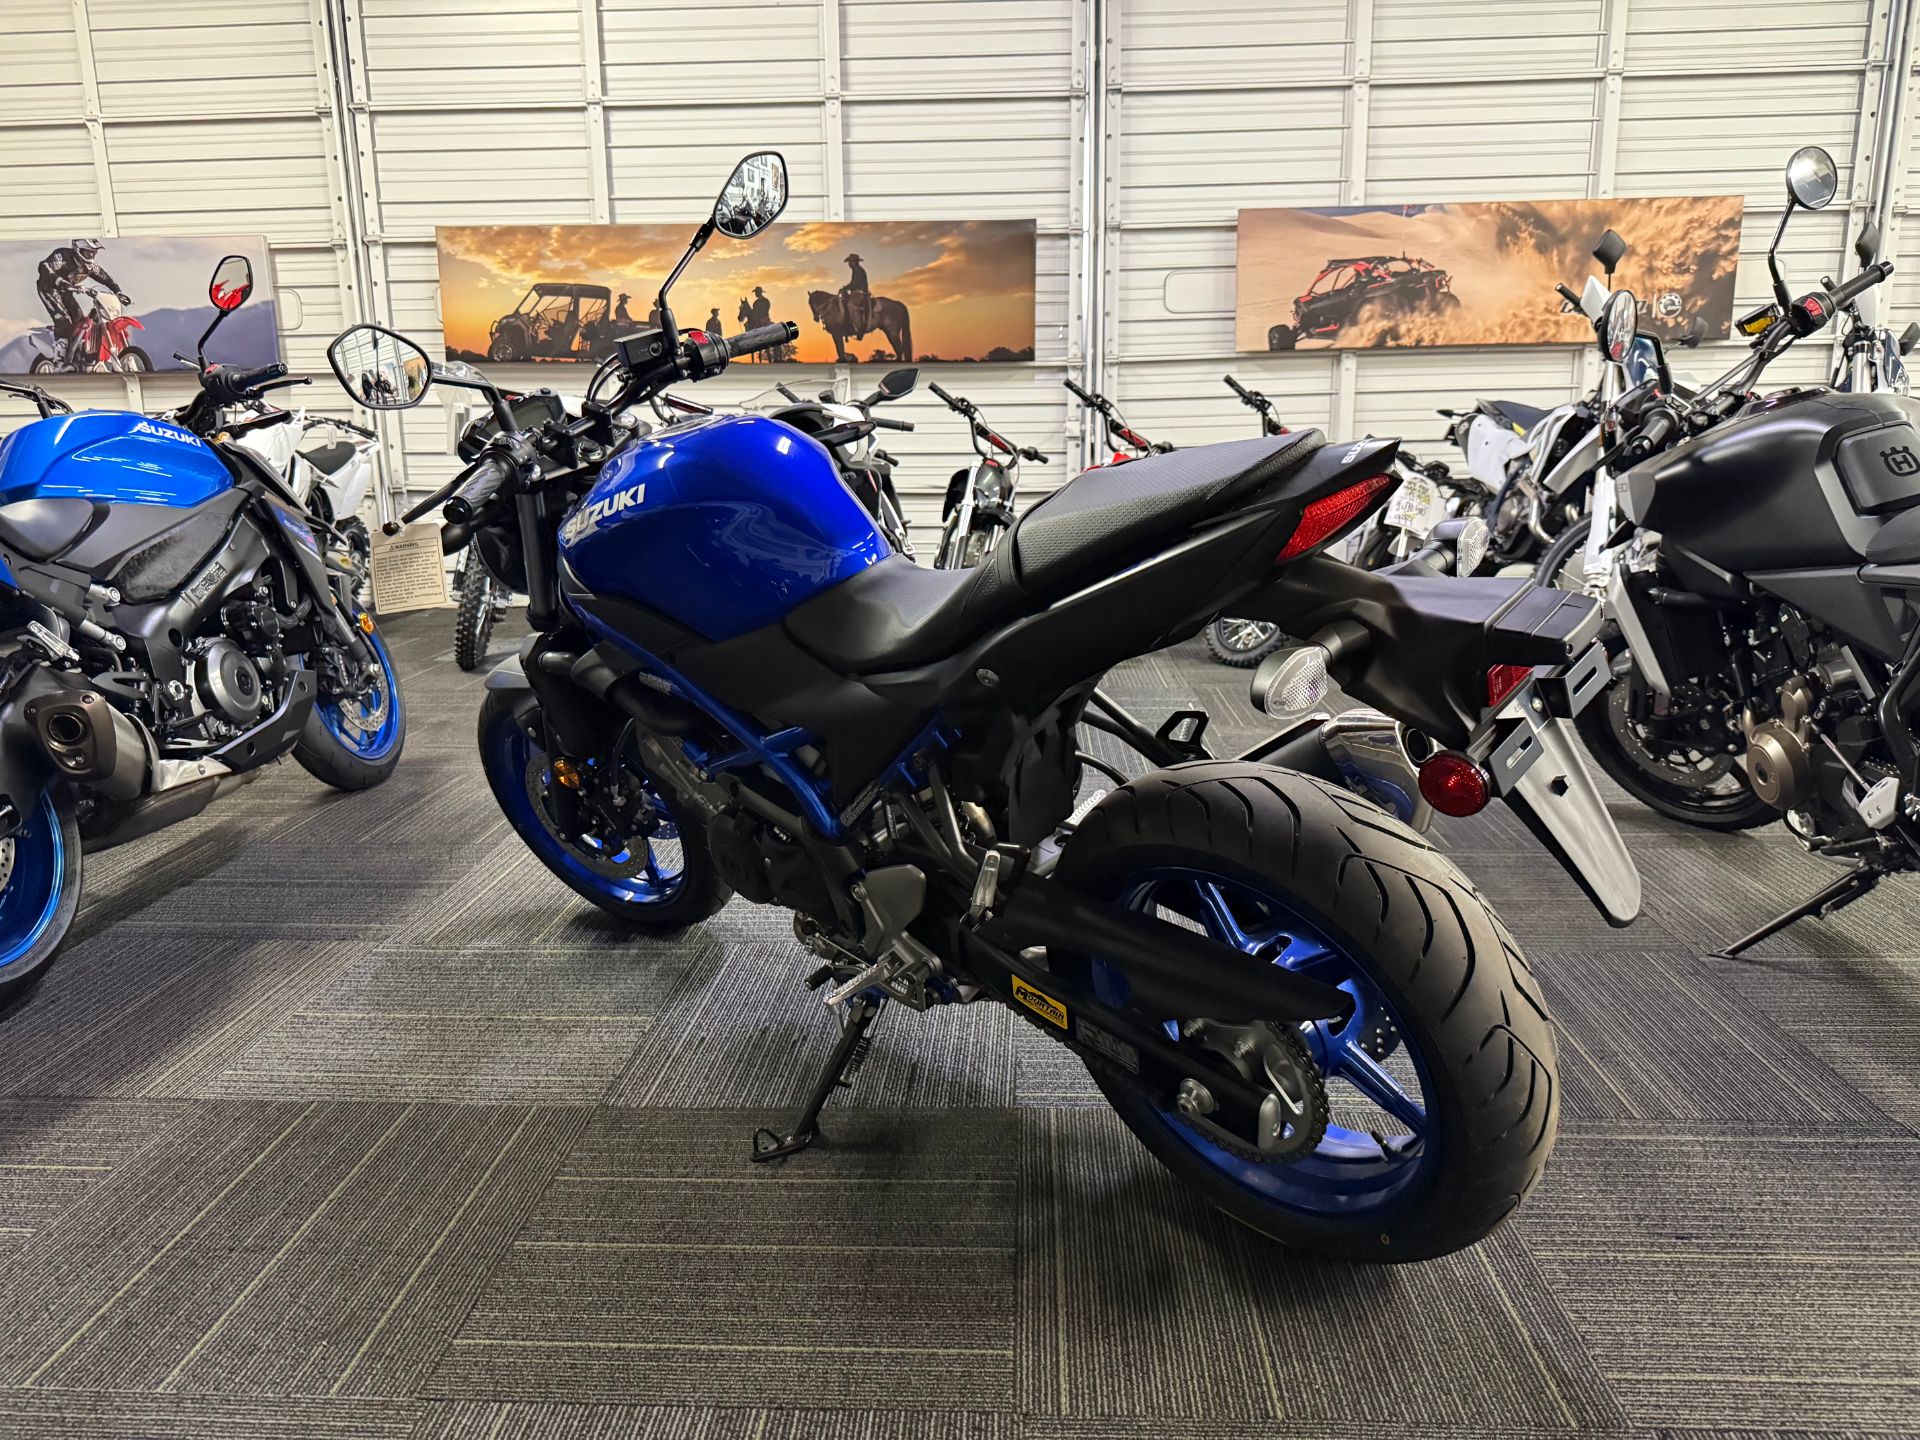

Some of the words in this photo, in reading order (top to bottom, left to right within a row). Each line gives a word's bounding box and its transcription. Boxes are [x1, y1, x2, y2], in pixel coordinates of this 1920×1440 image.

[136, 421, 202, 448] SUZUKI
[565, 483, 646, 539] SUZUKI
[394, 541, 419, 550] WARNING
[1016, 986, 1065, 1020] MOUNTAIN
